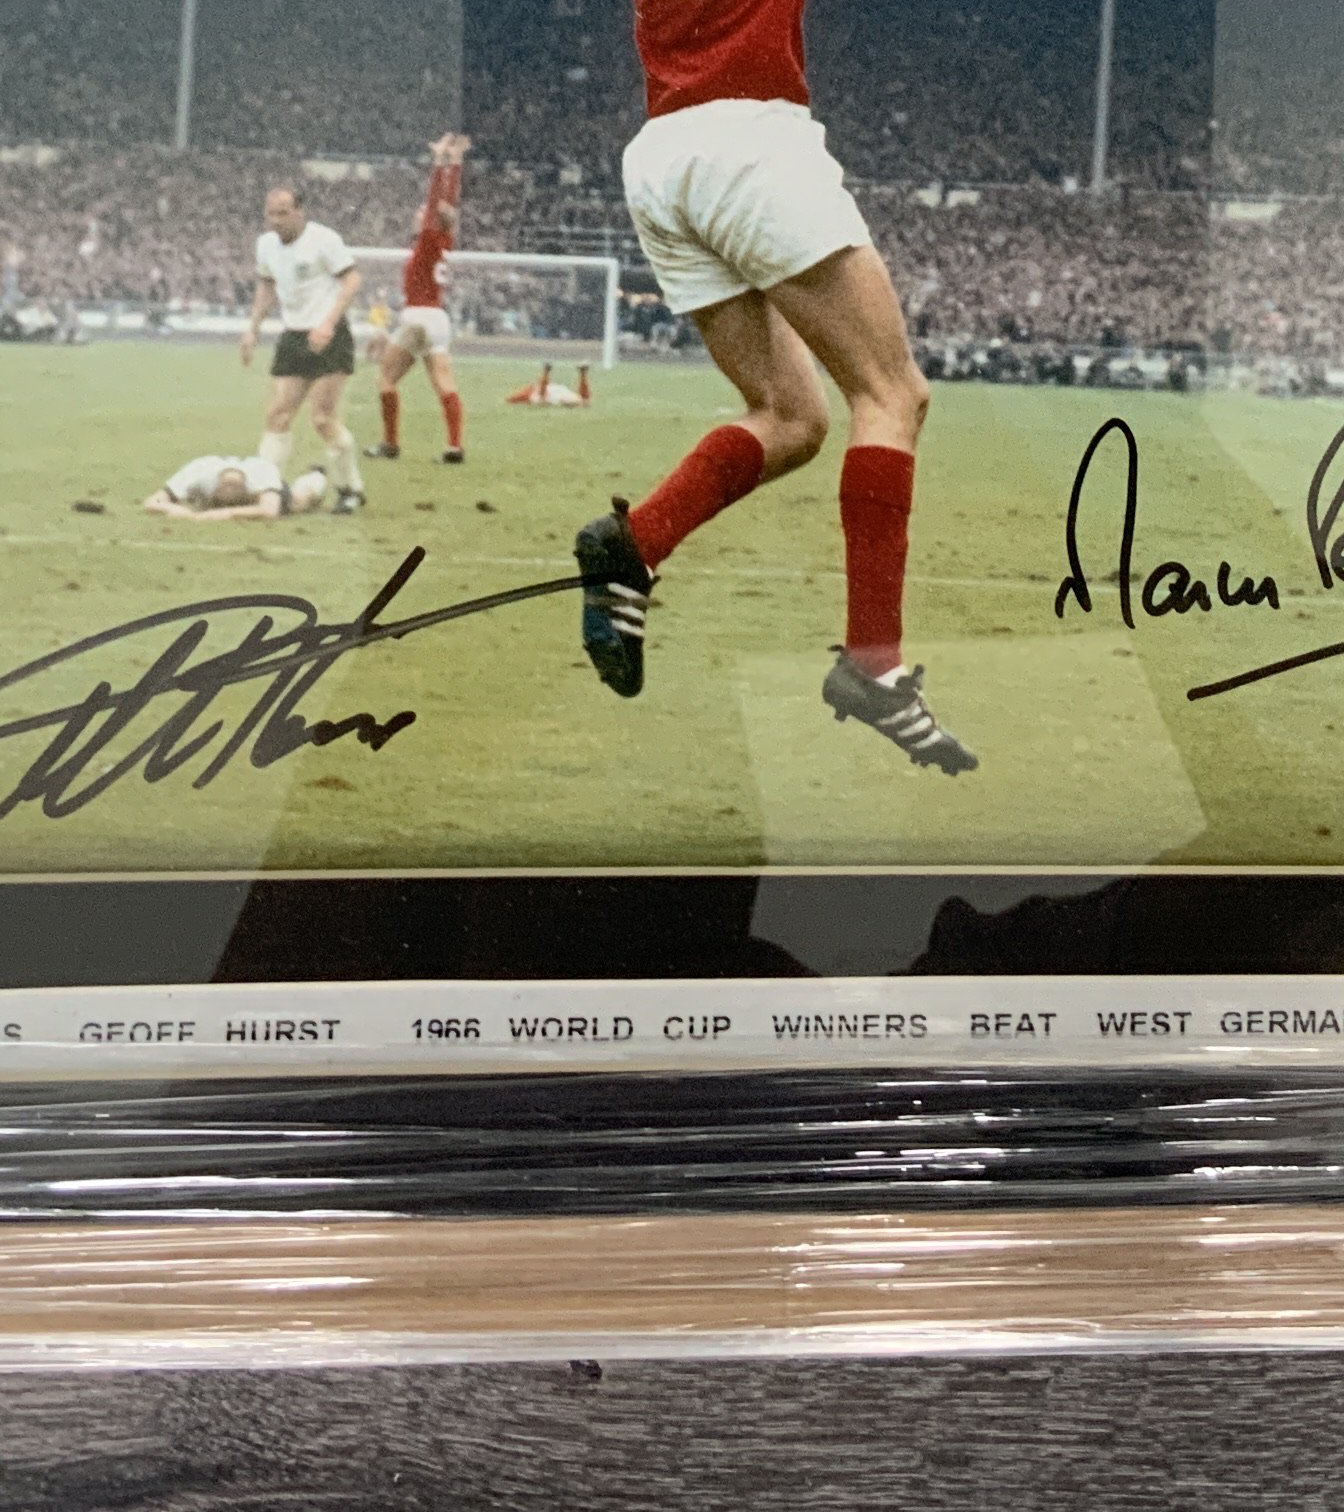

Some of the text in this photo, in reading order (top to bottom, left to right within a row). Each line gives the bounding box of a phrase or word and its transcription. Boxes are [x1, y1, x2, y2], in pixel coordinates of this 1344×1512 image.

[78, 1021, 197, 1044] GEOFF
[225, 1019, 341, 1043] HURST
[411, 1018, 482, 1041] 1966
[509, 1016, 635, 1042] WORLD
[663, 1015, 732, 1041] CUP
[772, 1014, 929, 1040] WINNERS
[969, 1012, 1058, 1039] BEAT
[1097, 1011, 1193, 1037] WEST
